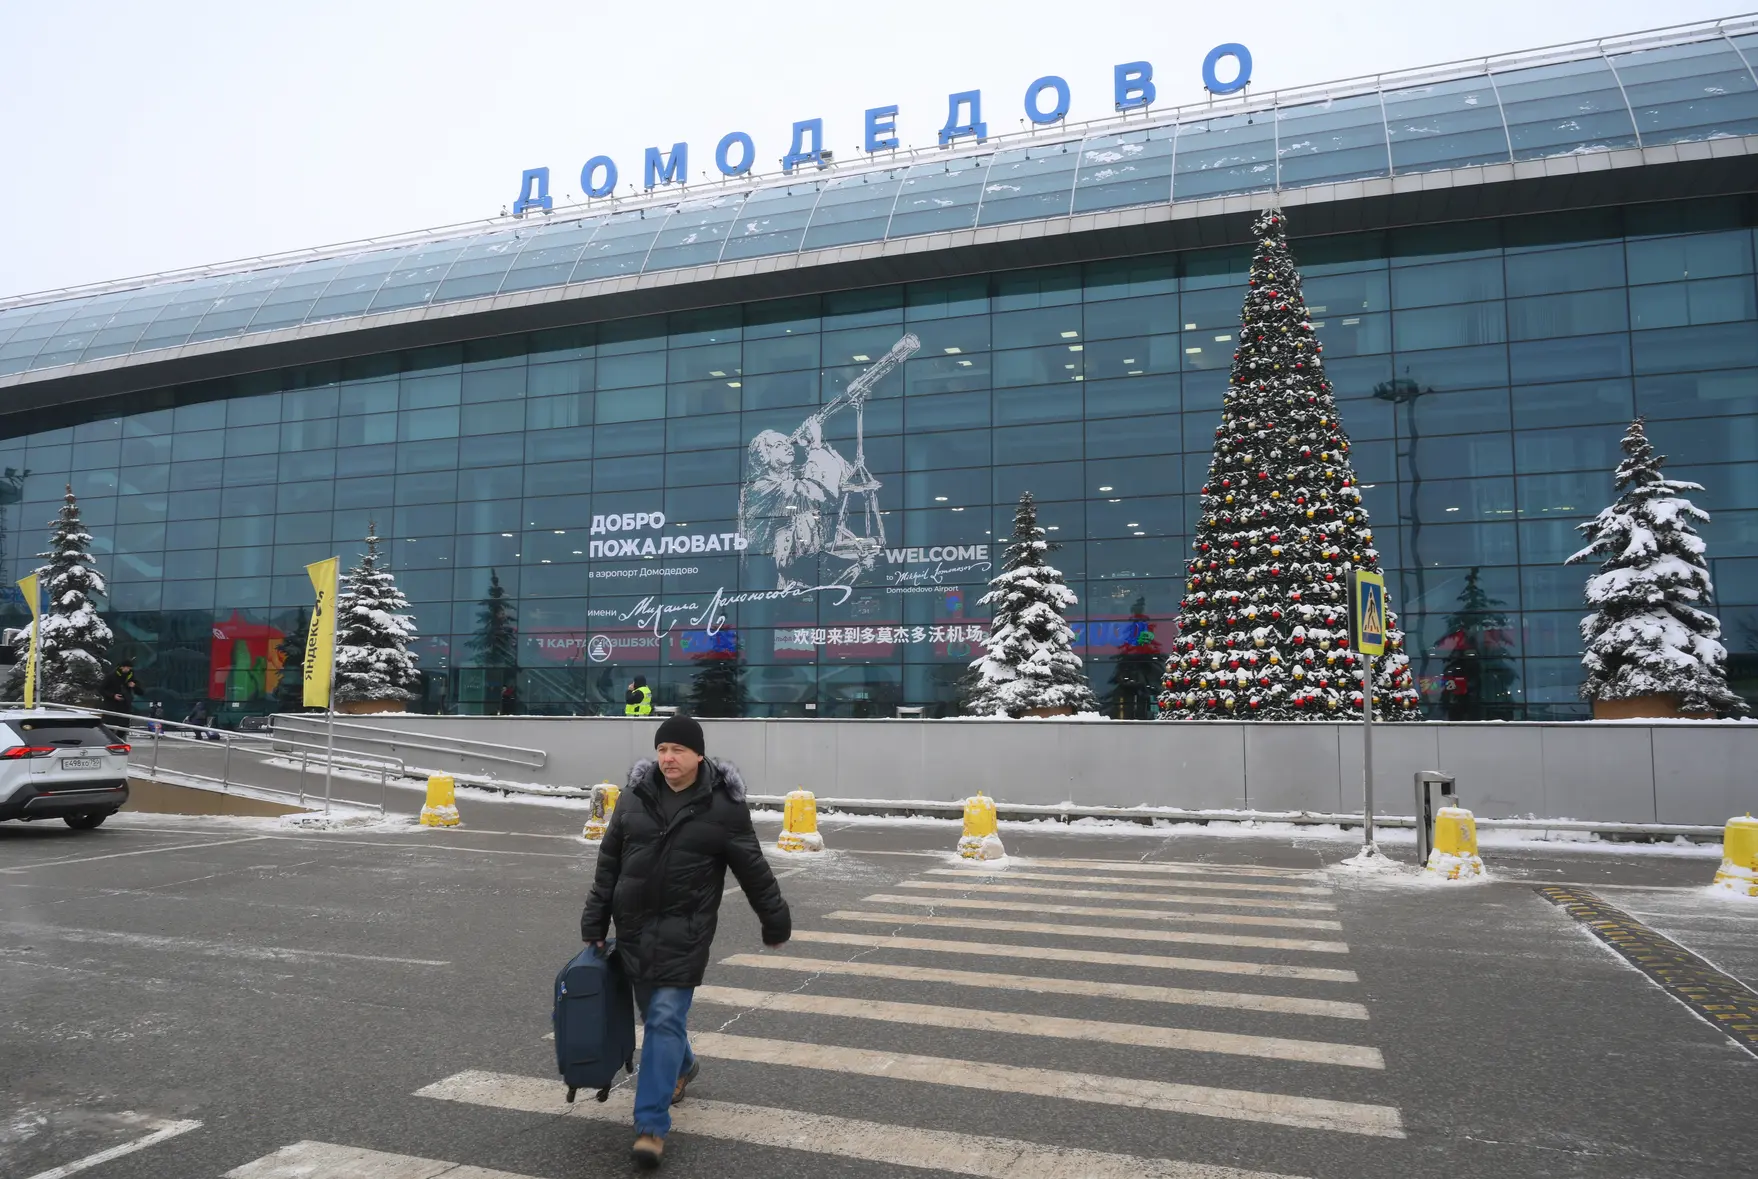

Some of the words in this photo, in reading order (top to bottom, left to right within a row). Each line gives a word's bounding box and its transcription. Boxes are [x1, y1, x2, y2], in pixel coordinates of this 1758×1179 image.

[513, 42, 1253, 214] ДОМОДЕДОВО
[590, 511, 666, 535] ДОБРО
[589, 533, 749, 558] ПОЖАЛОВАТЬ
[885, 545, 989, 564] WELCOME
[595, 568, 639, 579] аэропорт
[639, 566, 699, 577] Домодедово
[886, 586, 933, 594] Domodedovo
[933, 585, 959, 593] Airport
[588, 609, 617, 617] имени
[618, 595, 699, 639] Михаила
[690, 581, 852, 636] Ломоносова
[793, 625, 984, 645] 欢迎来到多莫杰多沃机场
